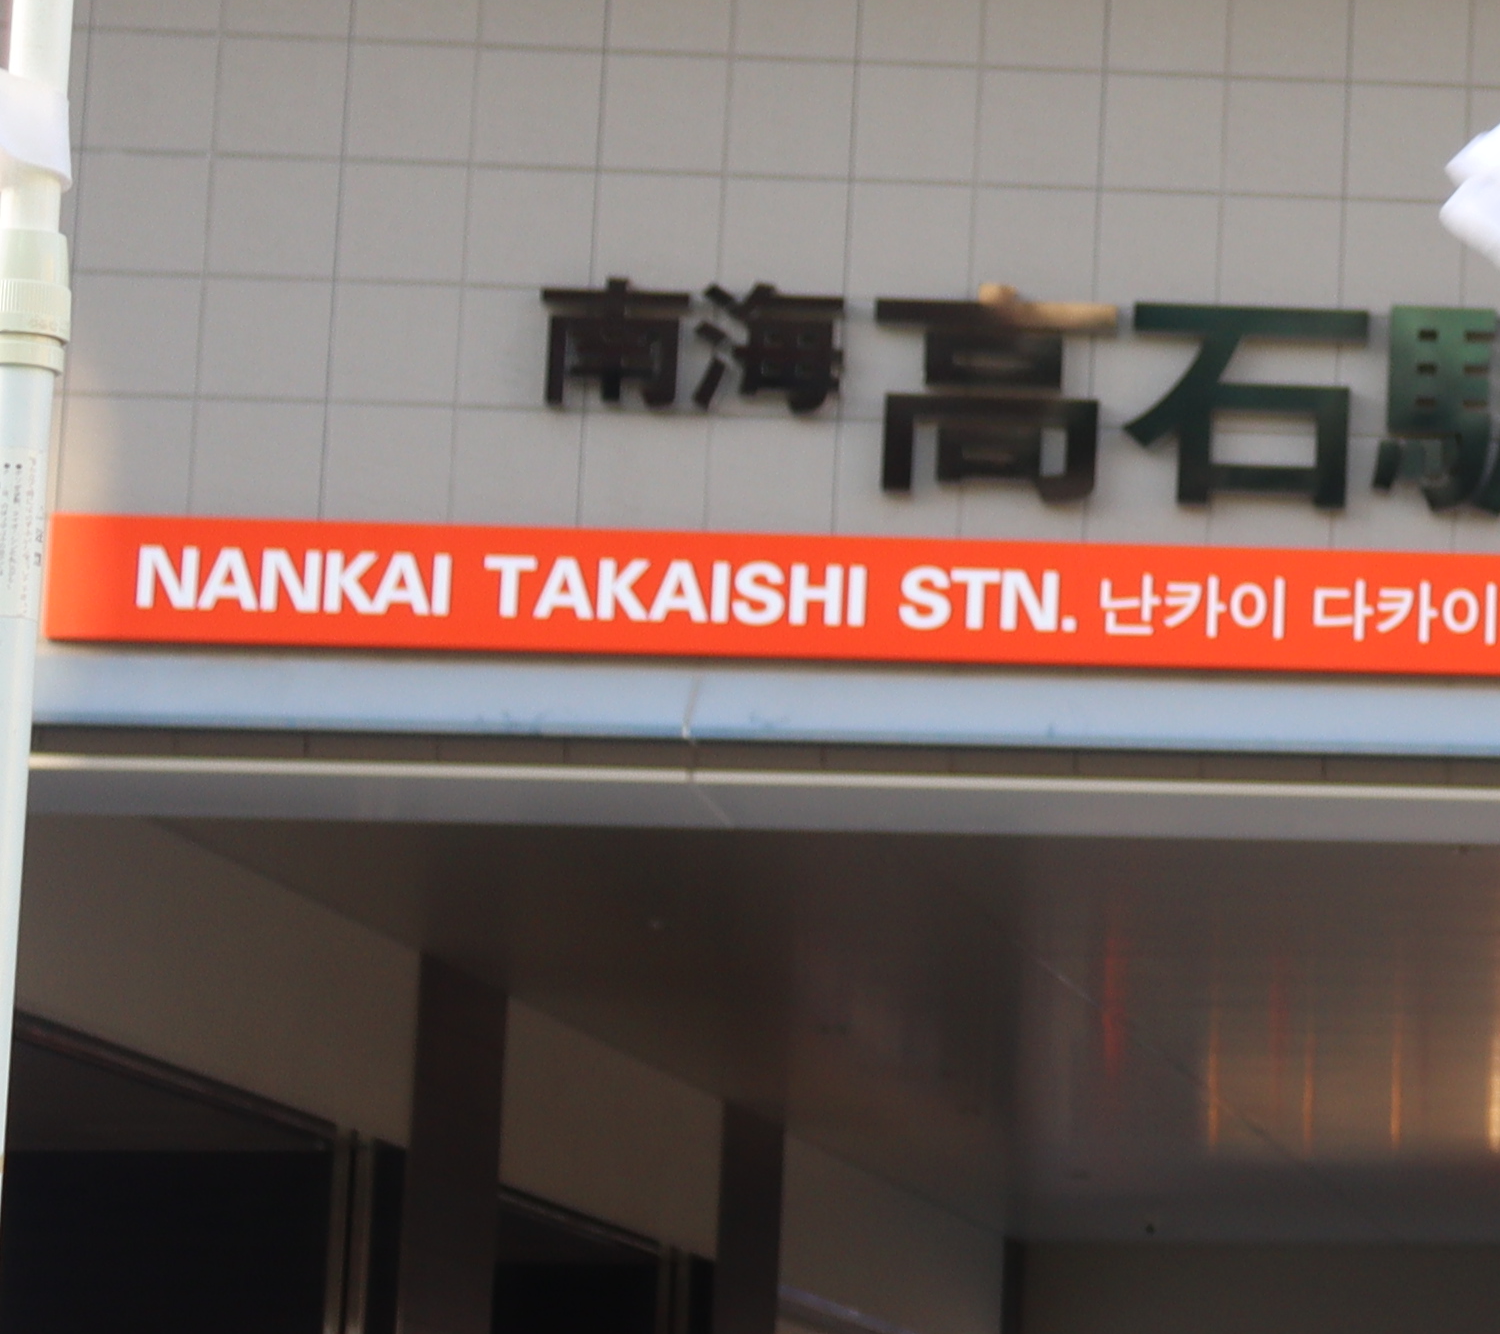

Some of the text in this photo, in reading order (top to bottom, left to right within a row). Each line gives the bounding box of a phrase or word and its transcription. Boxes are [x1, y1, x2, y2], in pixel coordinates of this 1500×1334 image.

[541, 277, 845, 413] 南海
[136, 546, 1077, 632] NANKAI TAKAISHI STN.
[1100, 574, 1285, 639] 난카이
